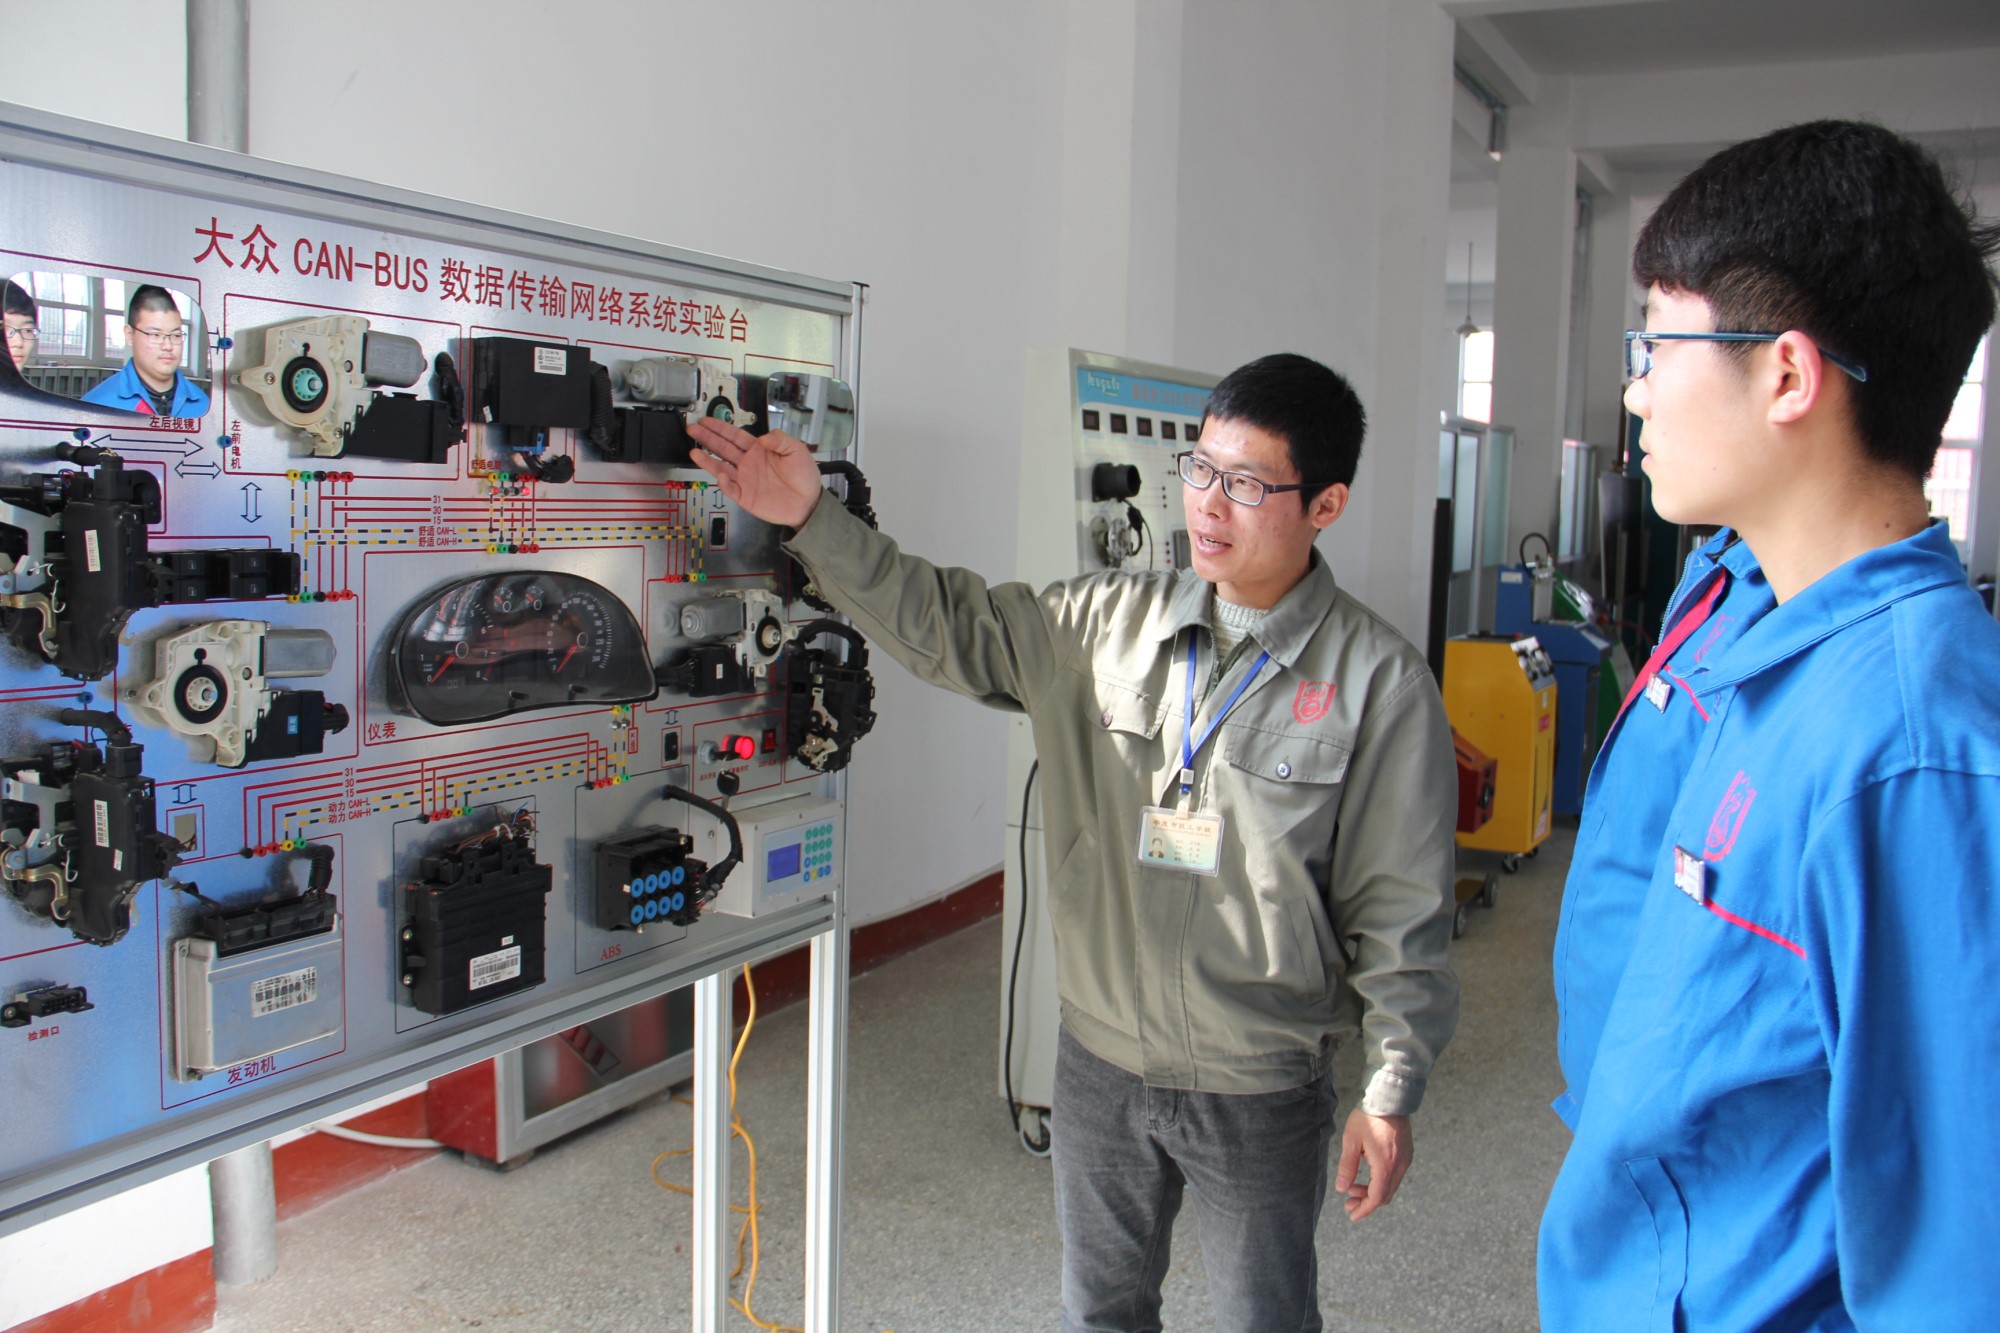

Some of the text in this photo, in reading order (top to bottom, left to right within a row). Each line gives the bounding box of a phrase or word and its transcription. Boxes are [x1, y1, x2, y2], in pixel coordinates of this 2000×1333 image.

[193, 216, 748, 343] 大众 CAN-BUS 数据传输网络系统实验台
[368, 721, 396, 741] 仪表
[344, 767, 354, 777] 31
[344, 778, 354, 788] 30
[345, 788, 354, 798] 15
[328, 798, 371, 813] 动力 CAN-L
[328, 808, 371, 824] 动力 CAN-H
[600, 943, 622, 960] ABS
[227, 1055, 276, 1084] 发动机
